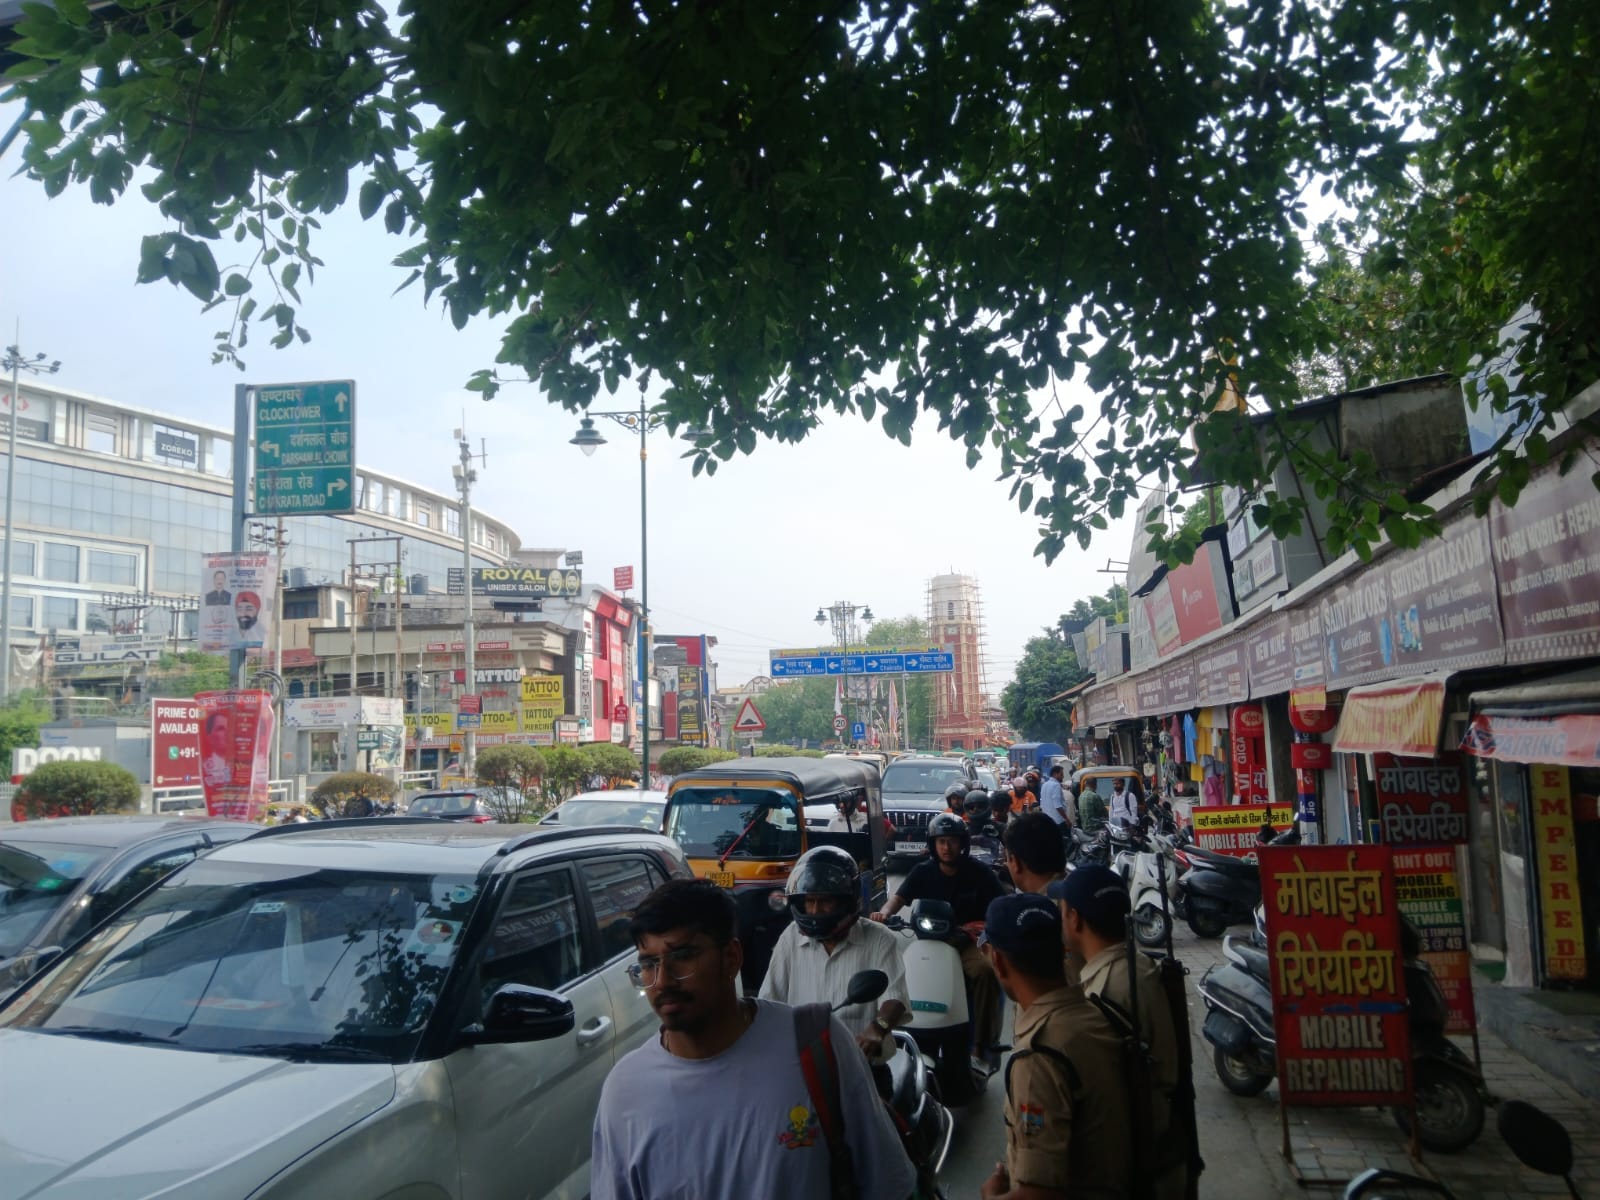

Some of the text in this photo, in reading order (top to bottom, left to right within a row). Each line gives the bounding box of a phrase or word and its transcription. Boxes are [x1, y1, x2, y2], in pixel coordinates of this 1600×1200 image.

[260, 406, 321, 421] CLOCKTOWER
[297, 472, 314, 489] रोड
[303, 495, 326, 507] ROAD
[1527, 512, 1567, 552] MOBILE
[1427, 531, 1485, 586] TELECOM
[482, 568, 547, 582] ROYAL
[487, 583, 547, 593] UNISEX SALON
[1345, 580, 1388, 628] TAILORS
[523, 682, 561, 694] TATTOO
[157, 707, 187, 718] PRIME
[405, 715, 440, 725] TATOO
[481, 713, 505, 723] TTOO
[525, 708, 553, 719] TATTOO
[159, 723, 199, 734] AVAILAB
[836, 720, 846, 728] 20
[360, 733, 379, 741] EXIT
[1236, 737, 1247, 765] GIGA
[1496, 732, 1567, 758] PAIRING
[1378, 758, 1462, 798] मोबाइल
[1199, 832, 1258, 850] MOBILE REP
[1424, 853, 1452, 868] OUT
[1541, 770, 1581, 957] EMPERED
[1273, 850, 1383, 924] मोबाईल
[1395, 874, 1444, 887] MOBILE
[1395, 886, 1456, 900] EPAIRING
[1397, 901, 1449, 913] MOBILE
[1274, 929, 1396, 997] रिपेयरिंग
[1299, 1015, 1385, 1050] MOBILE
[1285, 1057, 1405, 1093] REPAIRING
